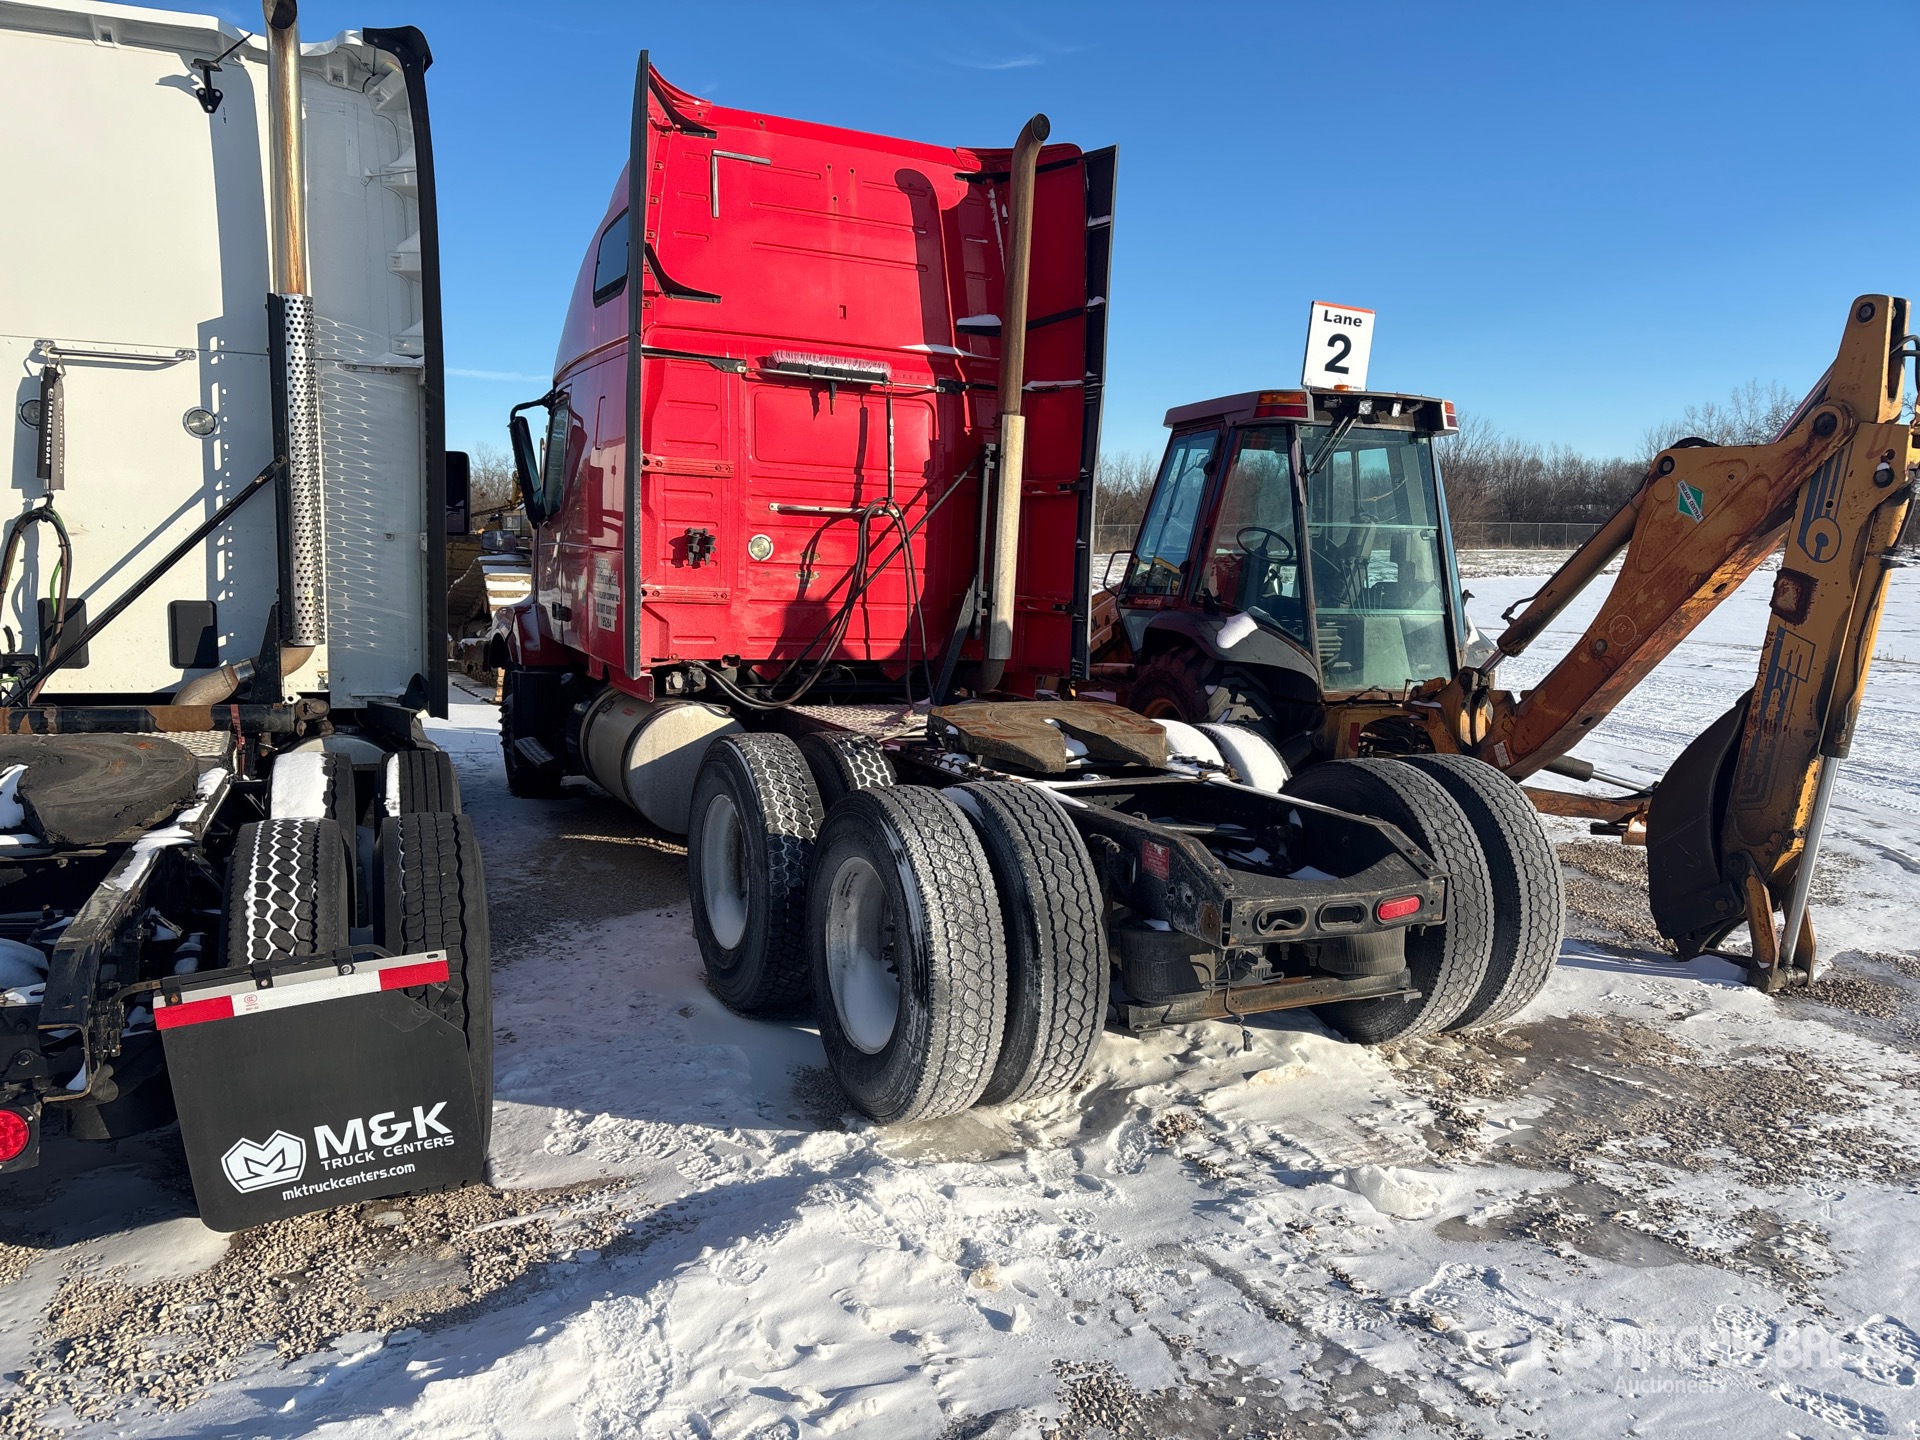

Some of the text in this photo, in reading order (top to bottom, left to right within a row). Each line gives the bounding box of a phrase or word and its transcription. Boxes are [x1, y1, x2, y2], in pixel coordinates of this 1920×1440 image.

[1323, 309, 1363, 327] Lane
[1324, 333, 1352, 375] 2
[313, 1101, 453, 1159] M&K
[320, 1135, 455, 1171] TRUCK CENTERS
[282, 1163, 416, 1200] mktruckcenters.com
